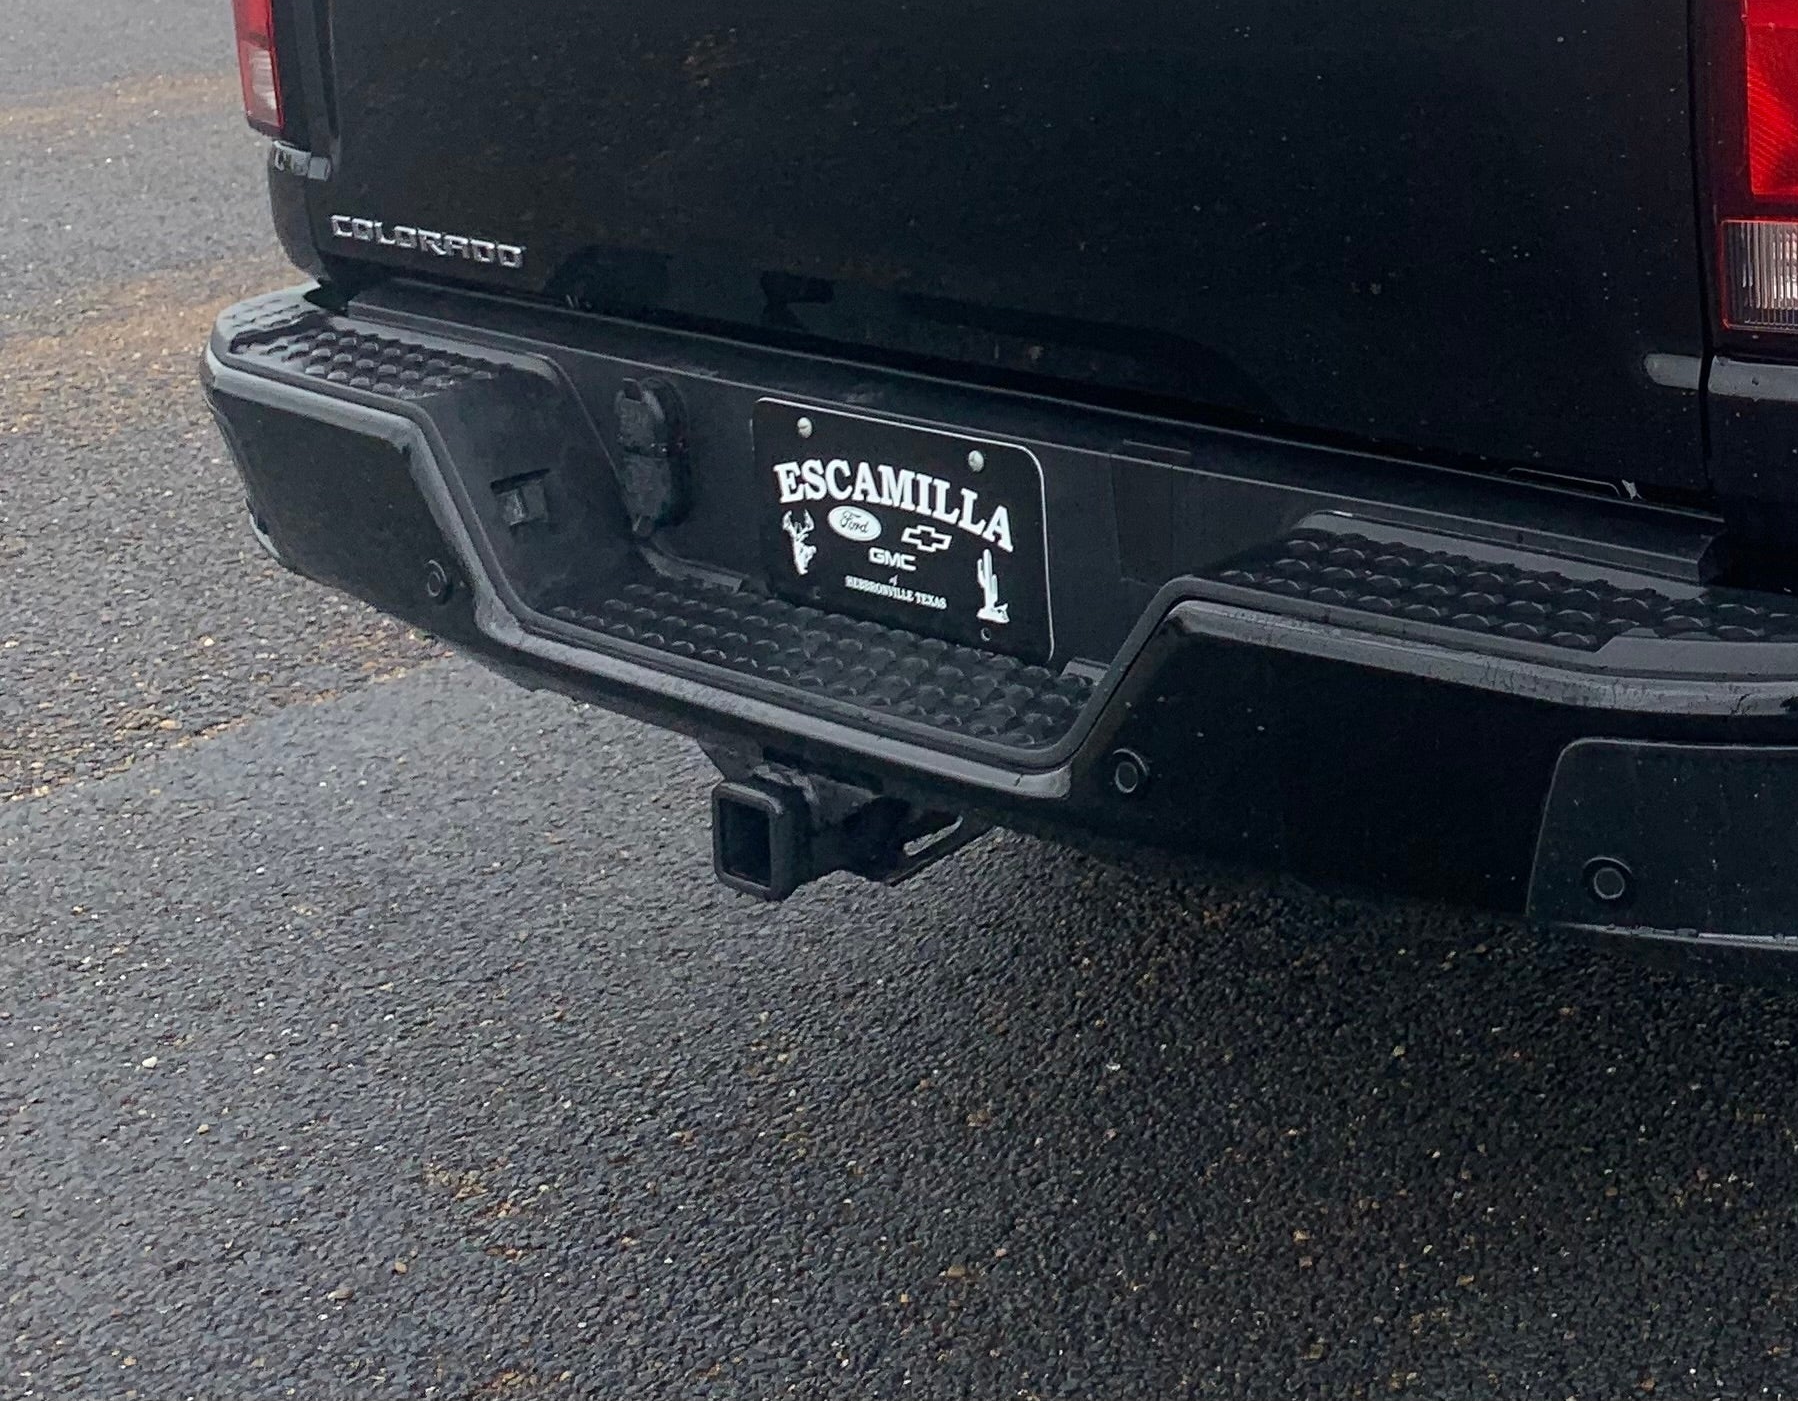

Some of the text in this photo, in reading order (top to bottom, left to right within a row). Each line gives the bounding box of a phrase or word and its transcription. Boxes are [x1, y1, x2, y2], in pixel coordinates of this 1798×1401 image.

[331, 214, 525, 269] COLORADO
[773, 459, 1014, 553] ESCAMILLA
[869, 547, 917, 572] GMC
[914, 591, 948, 610] TEXAS
